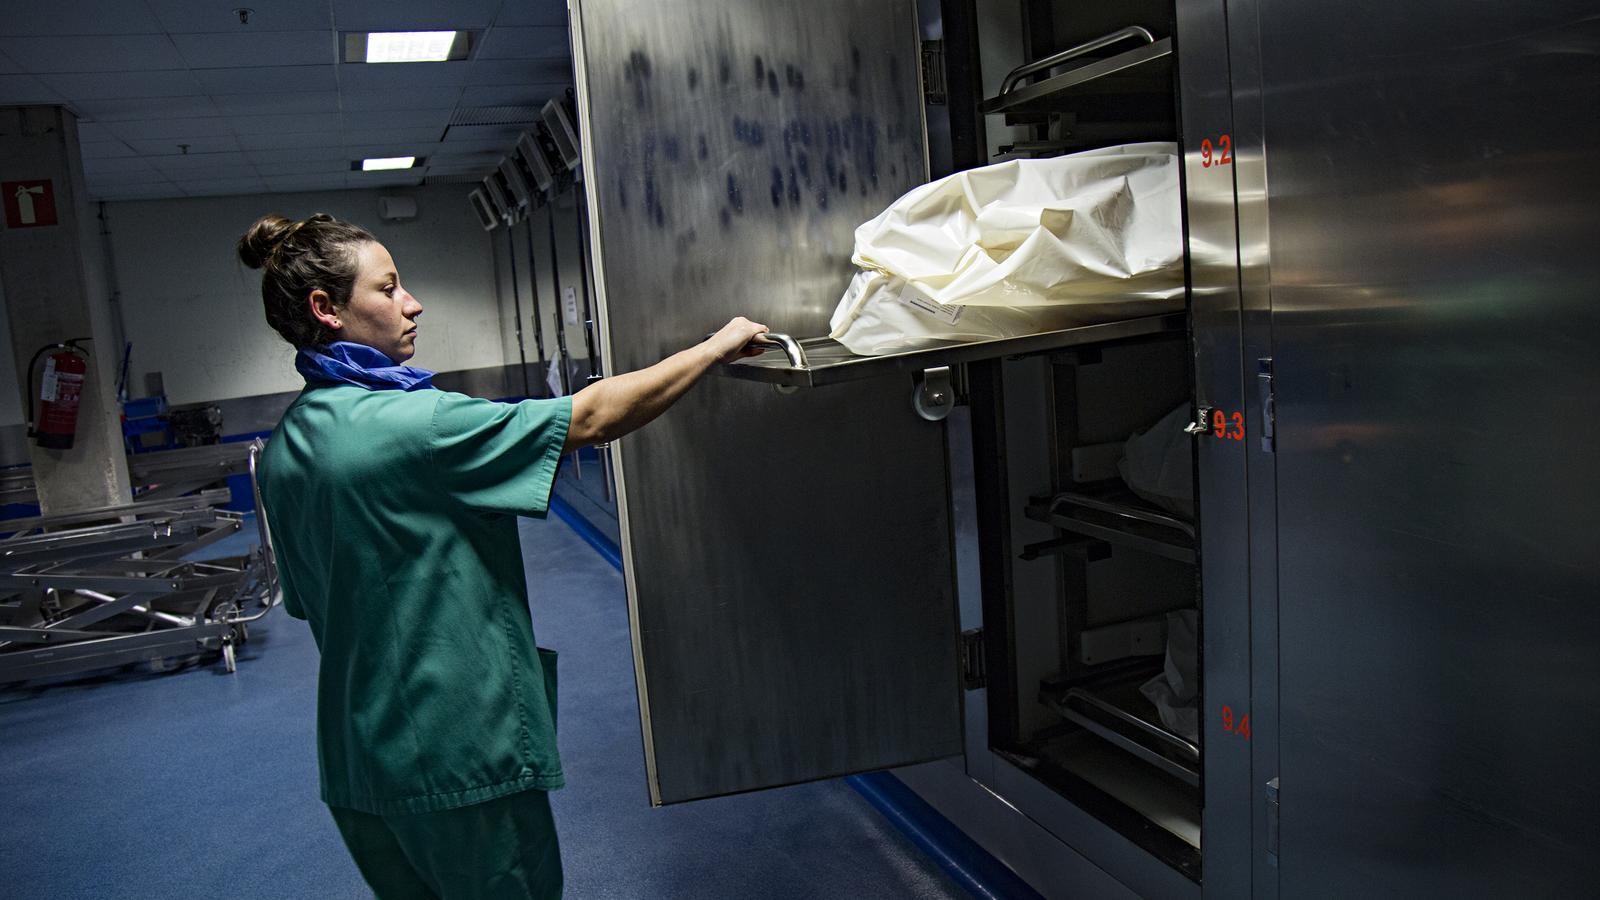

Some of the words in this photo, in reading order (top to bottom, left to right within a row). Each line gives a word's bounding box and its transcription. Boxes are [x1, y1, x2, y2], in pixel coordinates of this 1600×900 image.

[1201, 134, 1232, 168] 9.2
[1213, 410, 1245, 441] 9.3
[1221, 705, 1251, 740] 9.4
